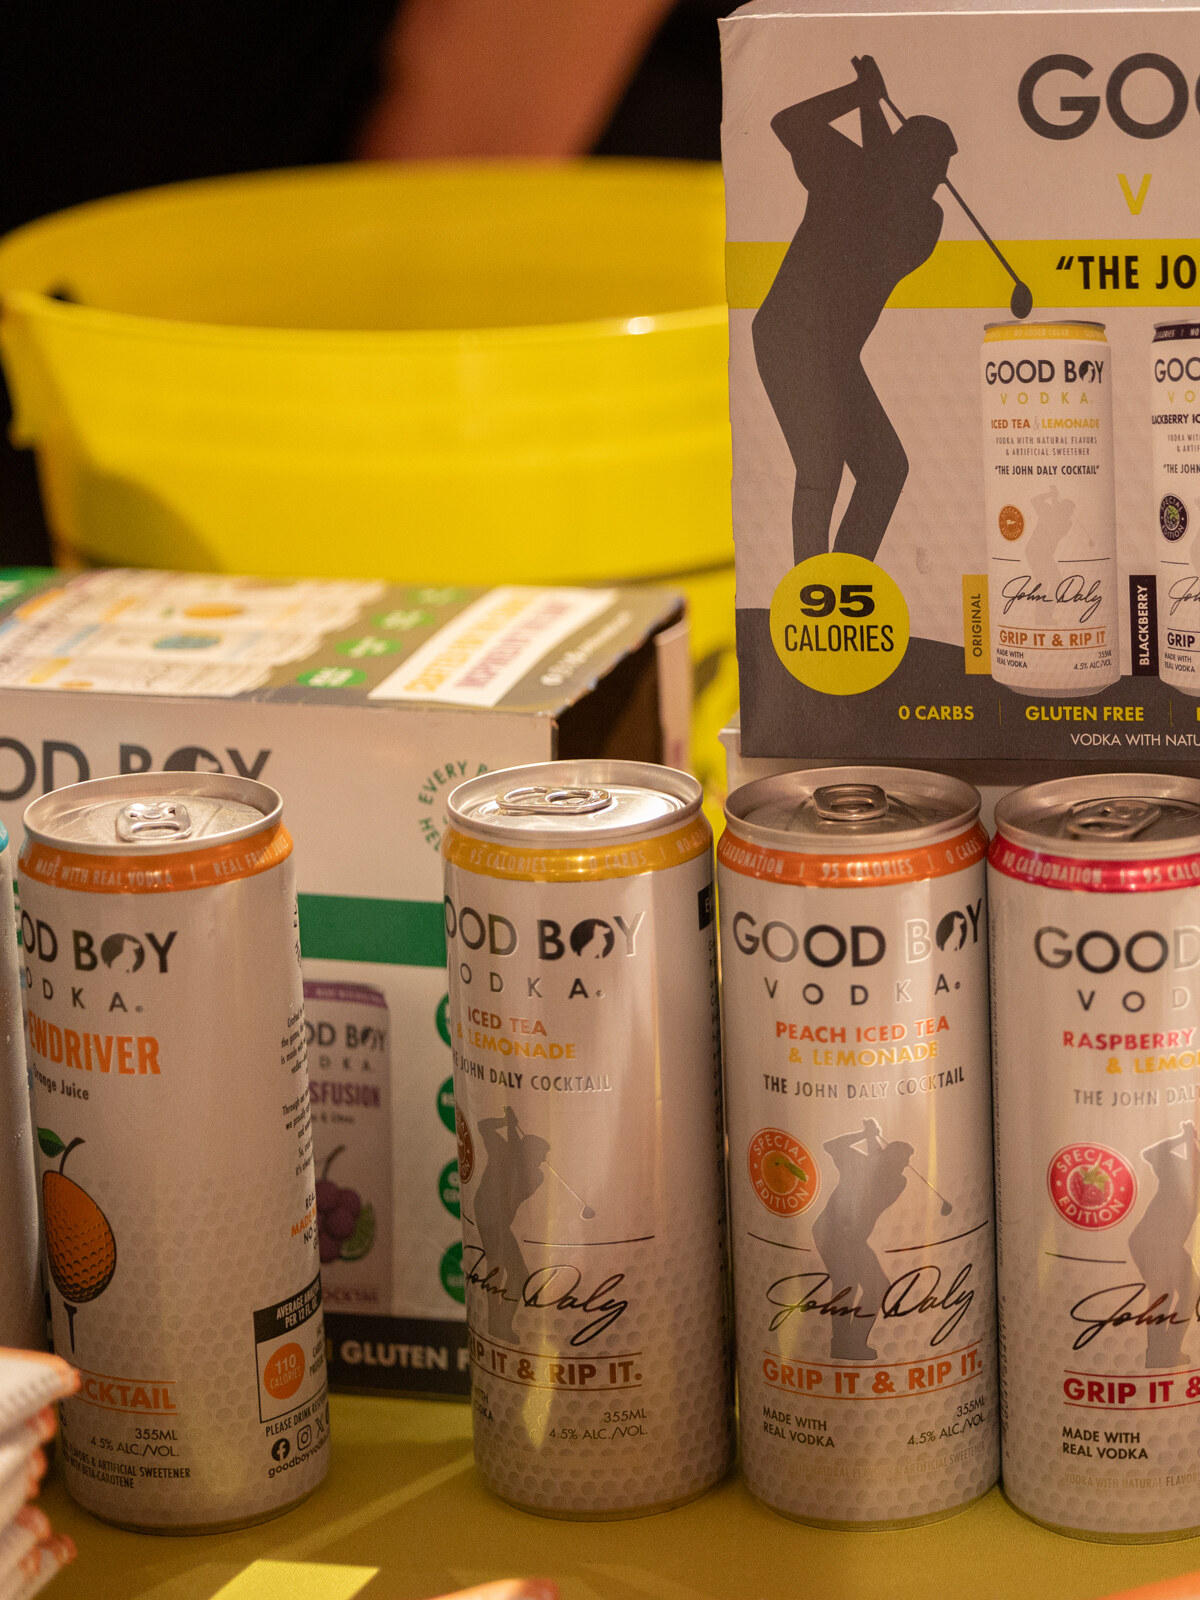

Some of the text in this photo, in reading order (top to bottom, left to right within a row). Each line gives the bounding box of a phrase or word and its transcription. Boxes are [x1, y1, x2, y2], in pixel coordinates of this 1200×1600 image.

[986, 359, 1104, 385] GOOD BOY
[1011, 418, 1100, 429] TEA LEMONADE
[1012, 464, 1033, 475] JOHN
[1036, 464, 1058, 475] DALY
[799, 584, 876, 619] 95
[784, 623, 895, 652] CALORIES
[973, 593, 982, 658] ORIGINAL
[1139, 584, 1149, 666] BLACKBERRY
[1167, 633, 1195, 648] GRIP
[915, 705, 975, 720] CARBS
[1025, 705, 1144, 721] GLUTEN FREE
[1070, 733, 1121, 746] VODKA
[1125, 733, 1161, 746] WITH
[417, 760, 469, 805] EVERY
[214, 859, 243, 878] REAL
[486, 853, 547, 873] CALORIES
[846, 859, 914, 878] CALORIES
[92, 869, 122, 885] REAL
[537, 911, 646, 961] BOY
[733, 898, 982, 968] GOOD BOY
[72, 930, 178, 973] BOY
[468, 1006, 547, 1036] ICED TEA
[776, 1015, 949, 1044] PEACH ICED TEA
[468, 1028, 577, 1060] LEMONADE
[1063, 1027, 1195, 1051] RASPBERRY
[813, 1041, 939, 1067] LEMONADE
[60, 1079, 89, 1100] Juice
[489, 1068, 611, 1093] DALY COCKTAIL
[763, 1066, 965, 1099] THE JOHN DALY COCKTAIL
[752, 1135, 807, 1168] SPECIAL
[1055, 1148, 1121, 1179] SPECIAL
[755, 1178, 810, 1210] EDITION
[1058, 1194, 1125, 1225] EDITION
[766, 1272, 876, 1331] John
[275, 1353, 297, 1372] 110
[762, 1358, 952, 1394] GRIP IT & RIP
[1063, 1378, 1136, 1404] GRIP
[134, 1428, 178, 1441] 355ML
[265, 1418, 292, 1437] PLEASE
[1062, 1426, 1140, 1444] MADE WITH
[1062, 1442, 1149, 1460] REAL VODKA
[98, 1460, 191, 1479] ARTIFICIAL SWEETENER
